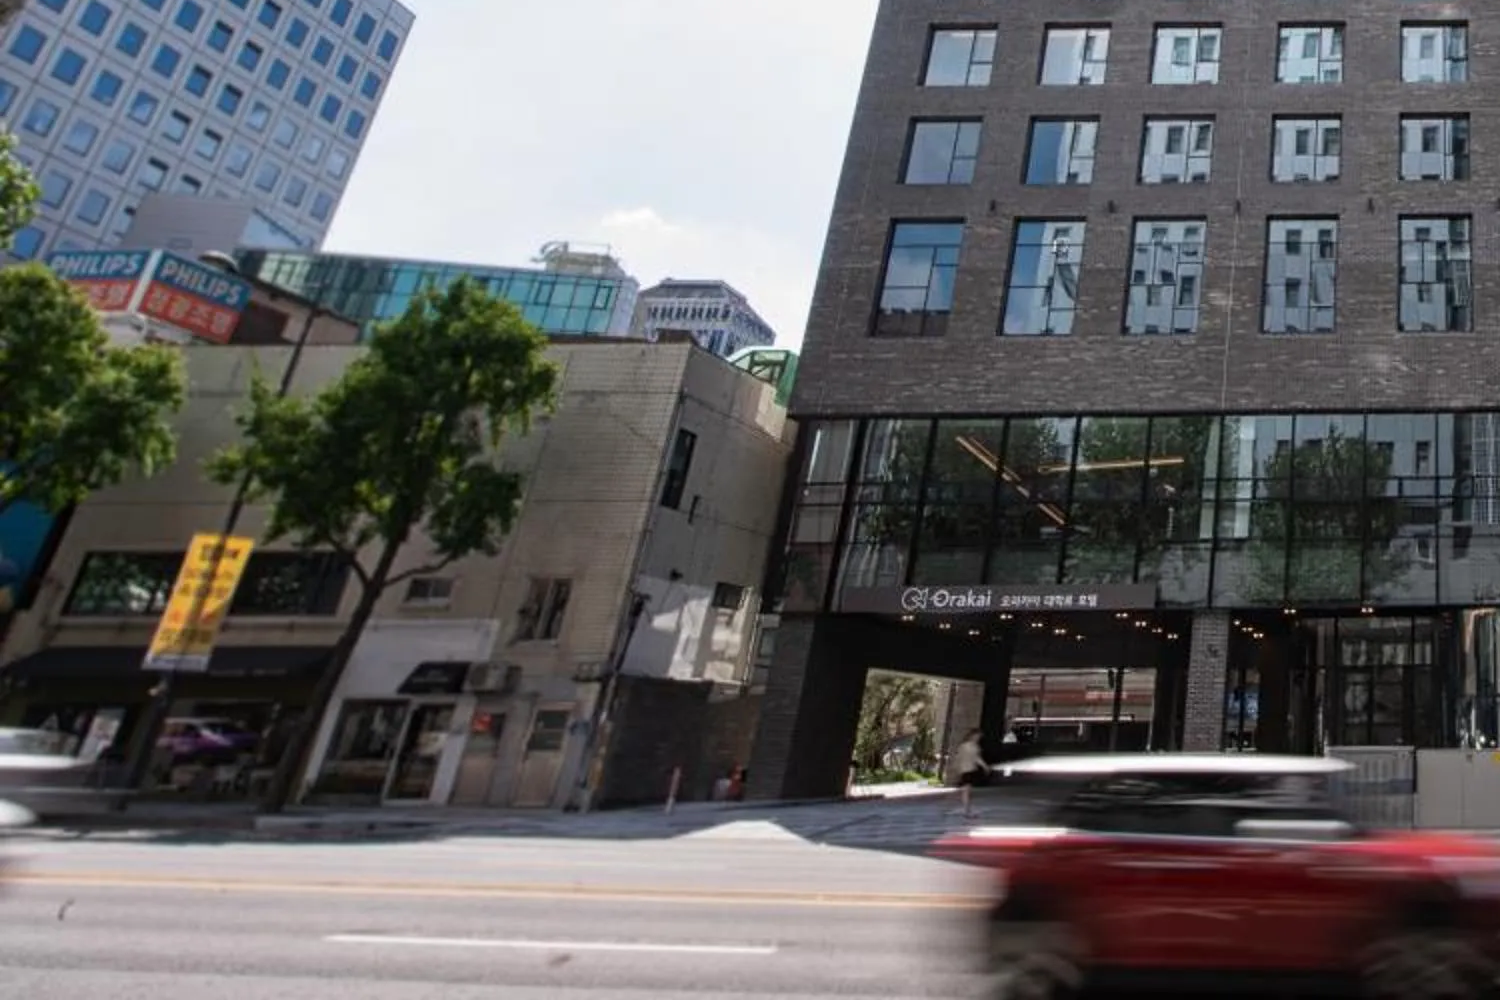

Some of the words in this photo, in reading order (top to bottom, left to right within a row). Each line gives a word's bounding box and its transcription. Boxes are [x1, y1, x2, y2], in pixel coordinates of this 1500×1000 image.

[51, 253, 144, 278] PHILIPS
[161, 259, 243, 305] PHILIPS
[930, 588, 992, 608] Orakai
